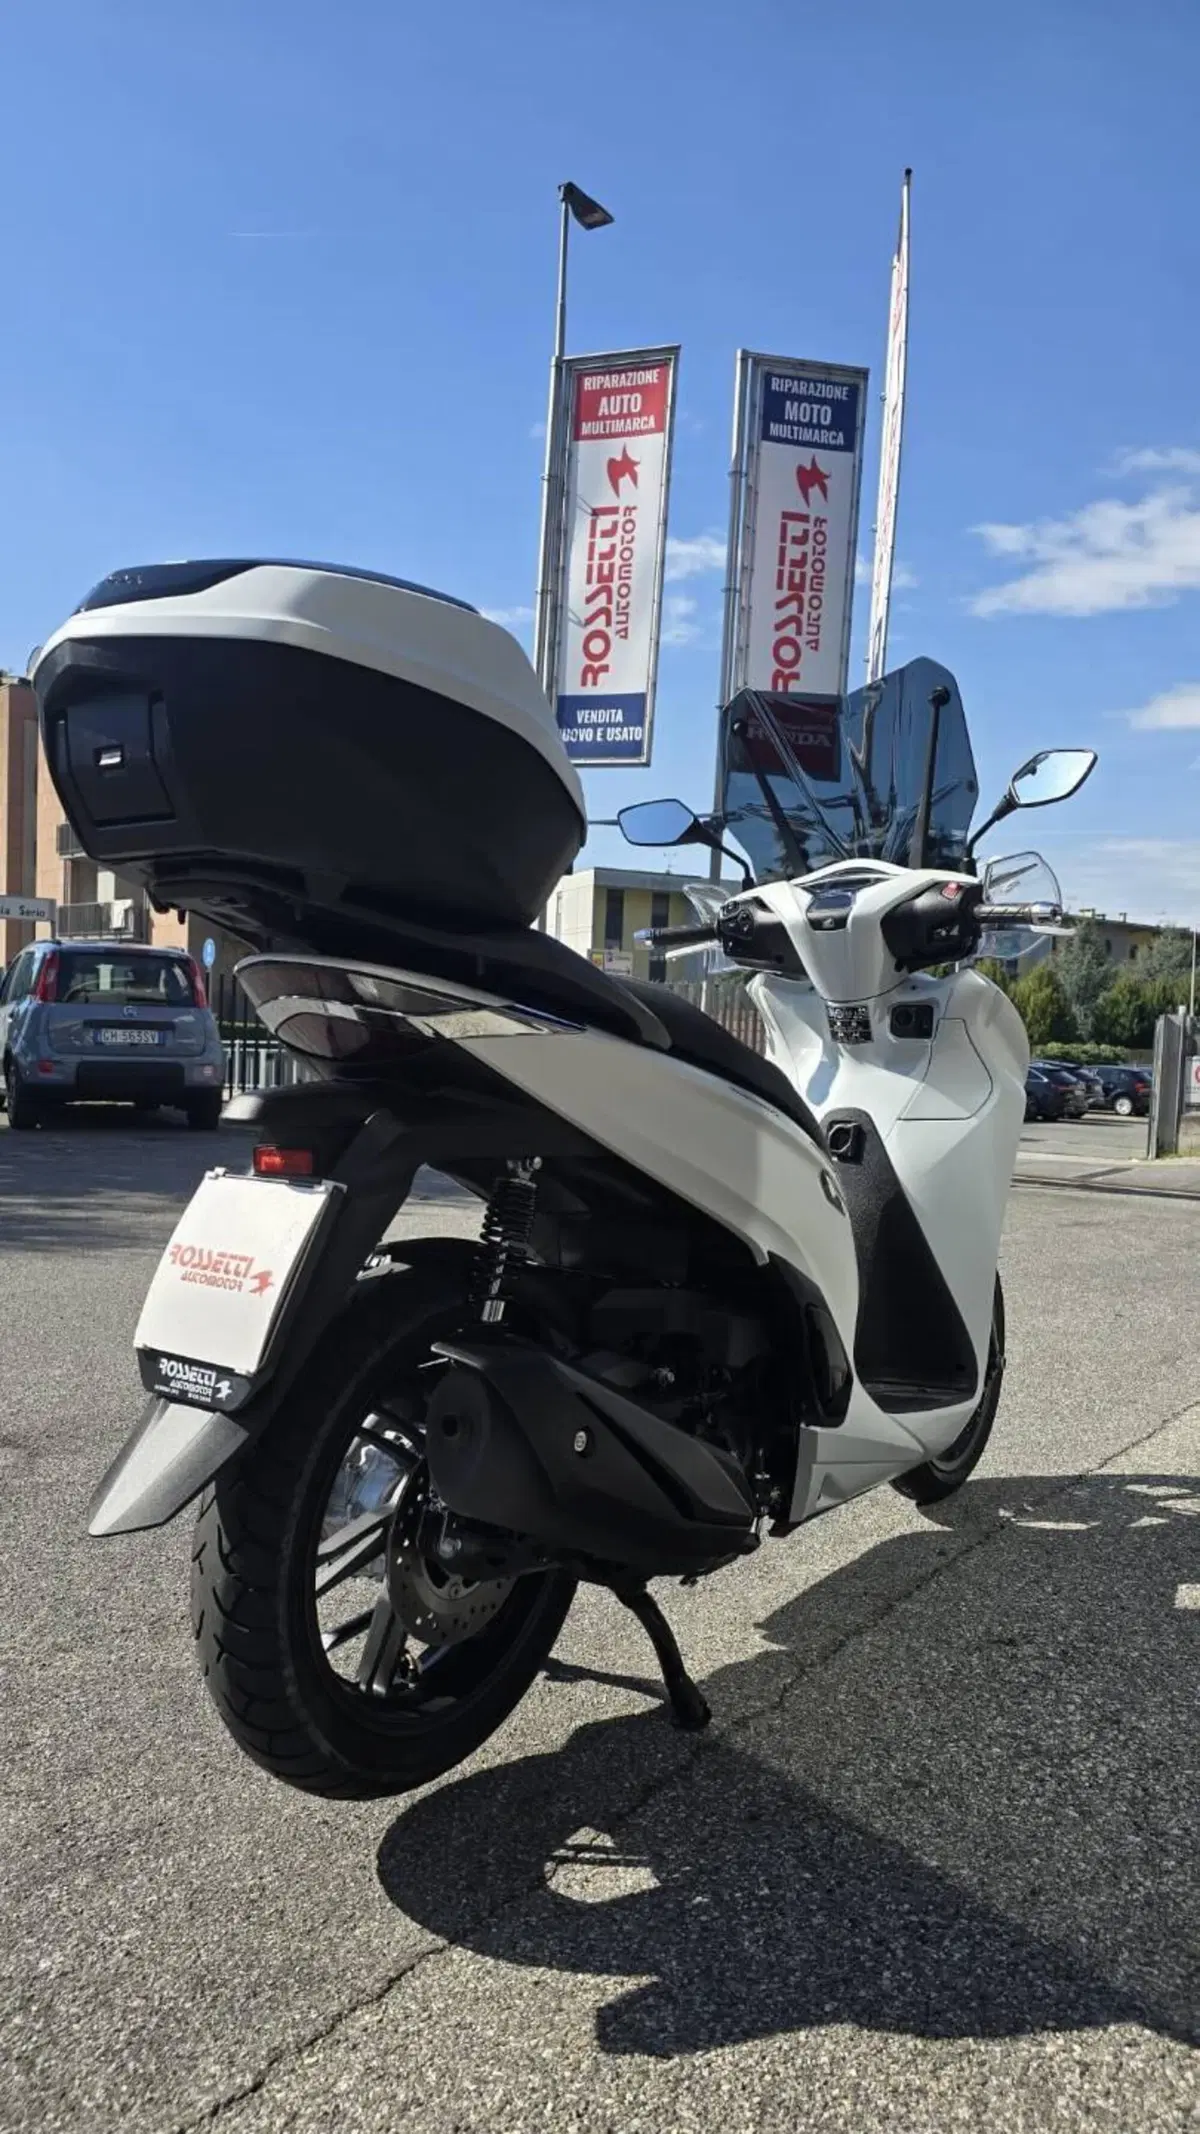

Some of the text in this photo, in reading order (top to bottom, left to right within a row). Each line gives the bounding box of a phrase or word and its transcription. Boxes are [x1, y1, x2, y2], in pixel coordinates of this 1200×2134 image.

[584, 368, 660, 391] RIPARAZIONE
[771, 377, 849, 401] RIPARAZIONE
[598, 392, 642, 417] AUTO
[785, 400, 832, 425] MOTO
[581, 414, 656, 436] MULTIMARCA
[769, 421, 844, 446] MULTIMARCA
[615, 505, 638, 640] AUTOMOTOR
[805, 516, 828, 652] AUTOMOTOR
[580, 506, 620, 687] ROSSETTI
[772, 511, 811, 693] ROSSETTI
[576, 708, 624, 724] VENDITA
[560, 726, 643, 742] UOVO E USATO
[169, 1243, 256, 1279] ROSSETTI
[159, 1358, 217, 1387] ROSSETTI
